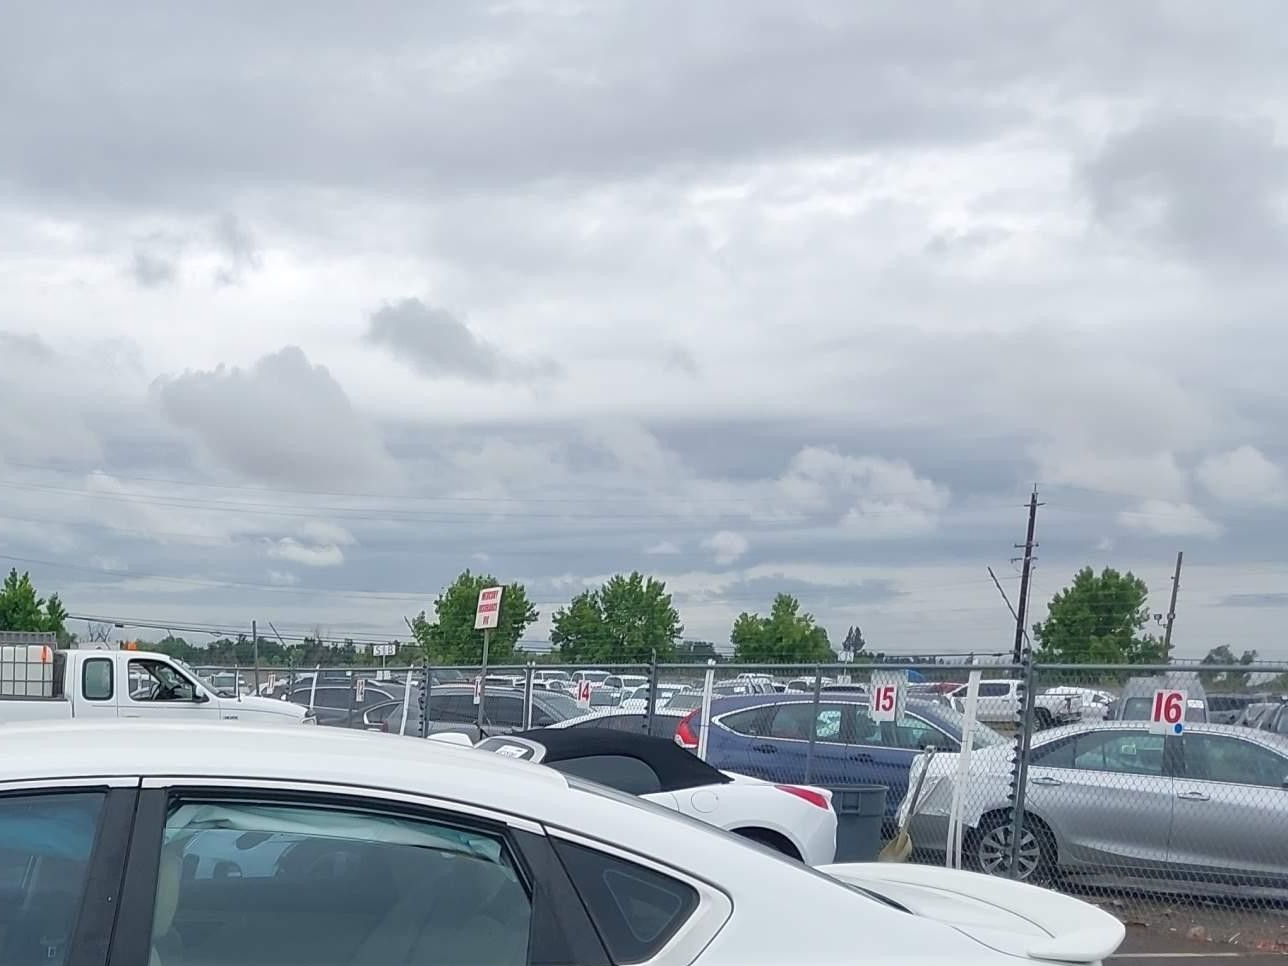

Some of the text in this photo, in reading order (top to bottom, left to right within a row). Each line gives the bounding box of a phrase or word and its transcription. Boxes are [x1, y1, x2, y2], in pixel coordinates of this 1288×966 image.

[578, 681, 590, 701] 14
[875, 687, 895, 712] 15
[1153, 692, 1183, 724] 16
